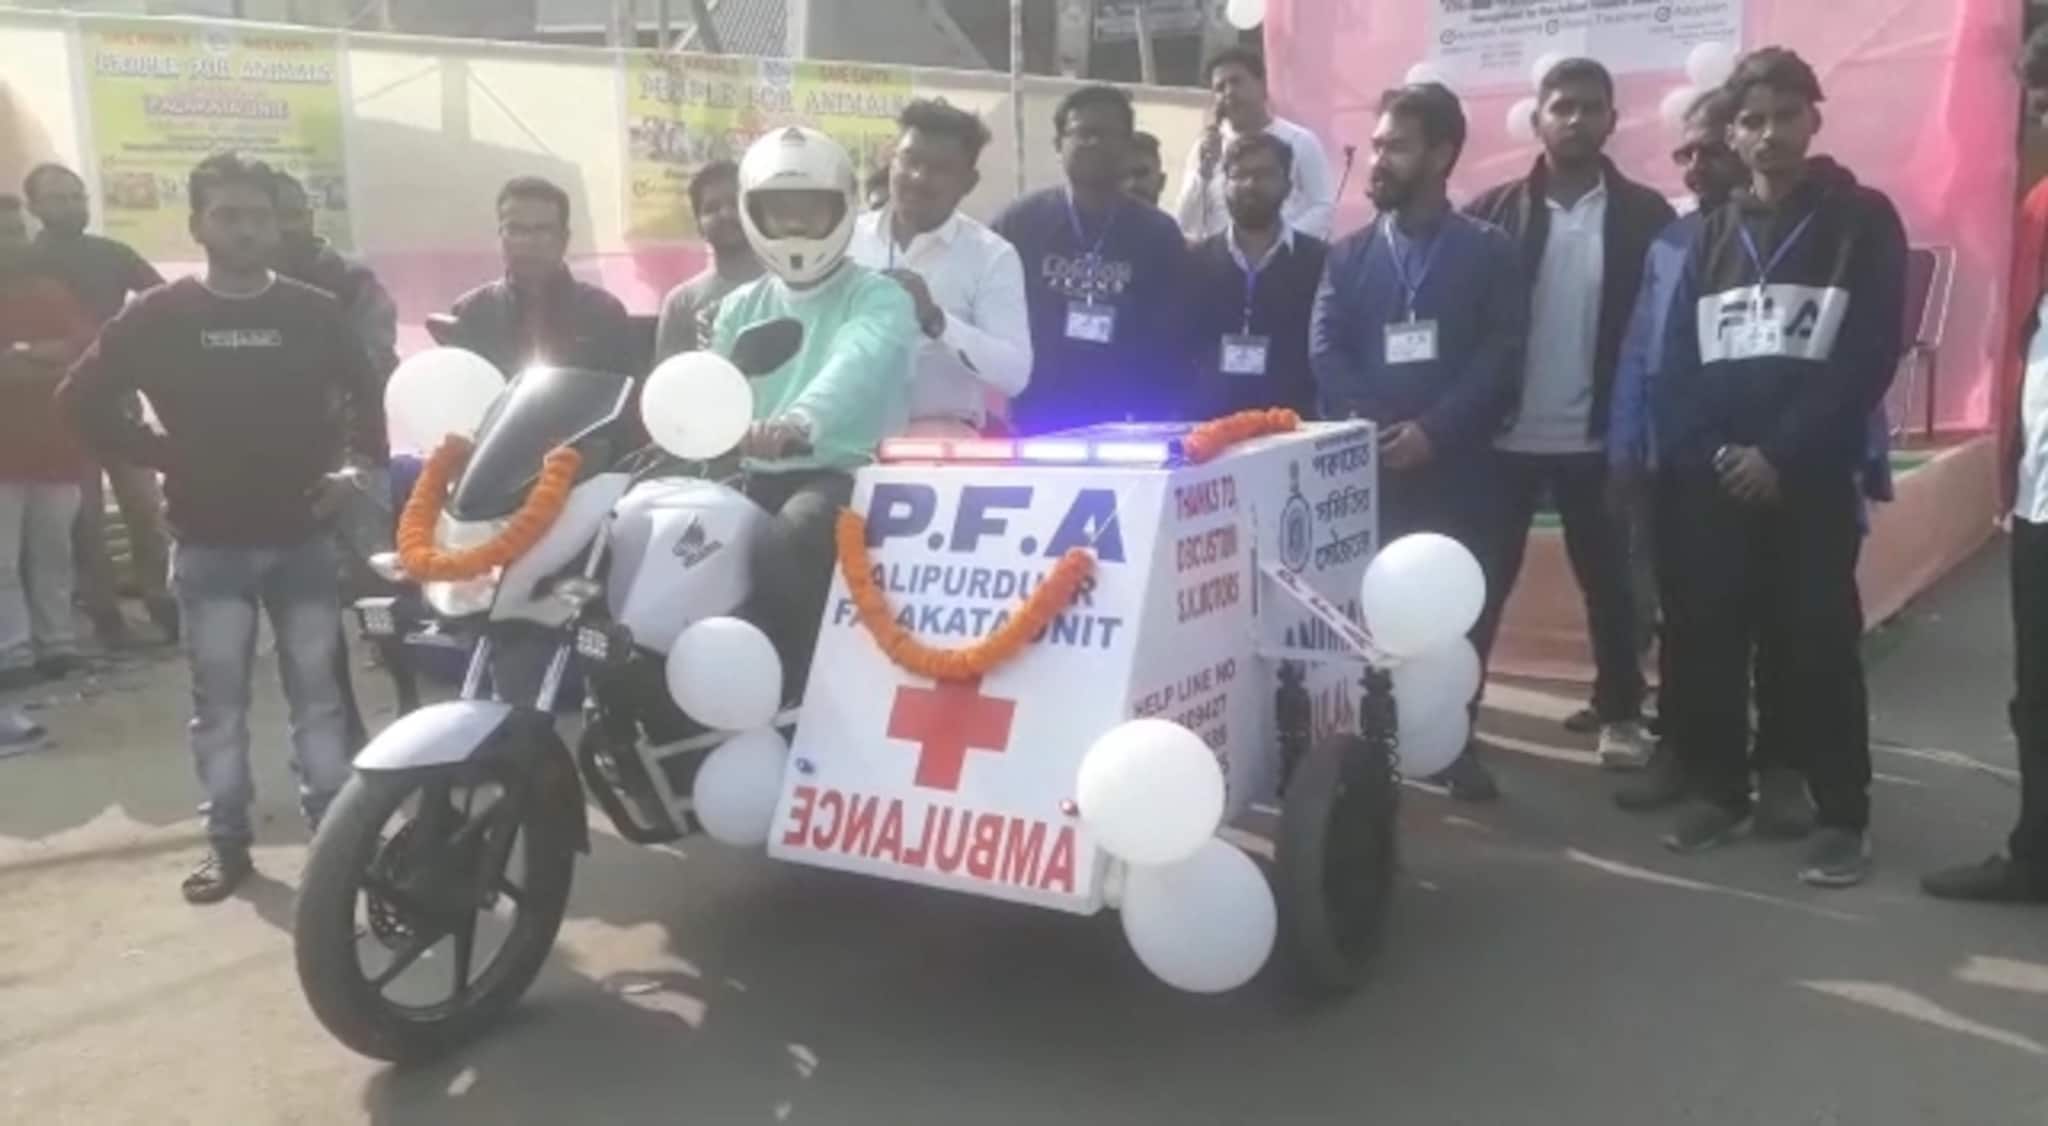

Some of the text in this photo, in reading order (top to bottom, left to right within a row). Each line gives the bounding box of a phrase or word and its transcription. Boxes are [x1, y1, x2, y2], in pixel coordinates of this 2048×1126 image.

[866, 483, 1126, 563] P.F.A
[868, 561, 1097, 607] ALIPURDUR
[833, 597, 1012, 637] FAKATA
[1177, 668, 1212, 703] LINE
